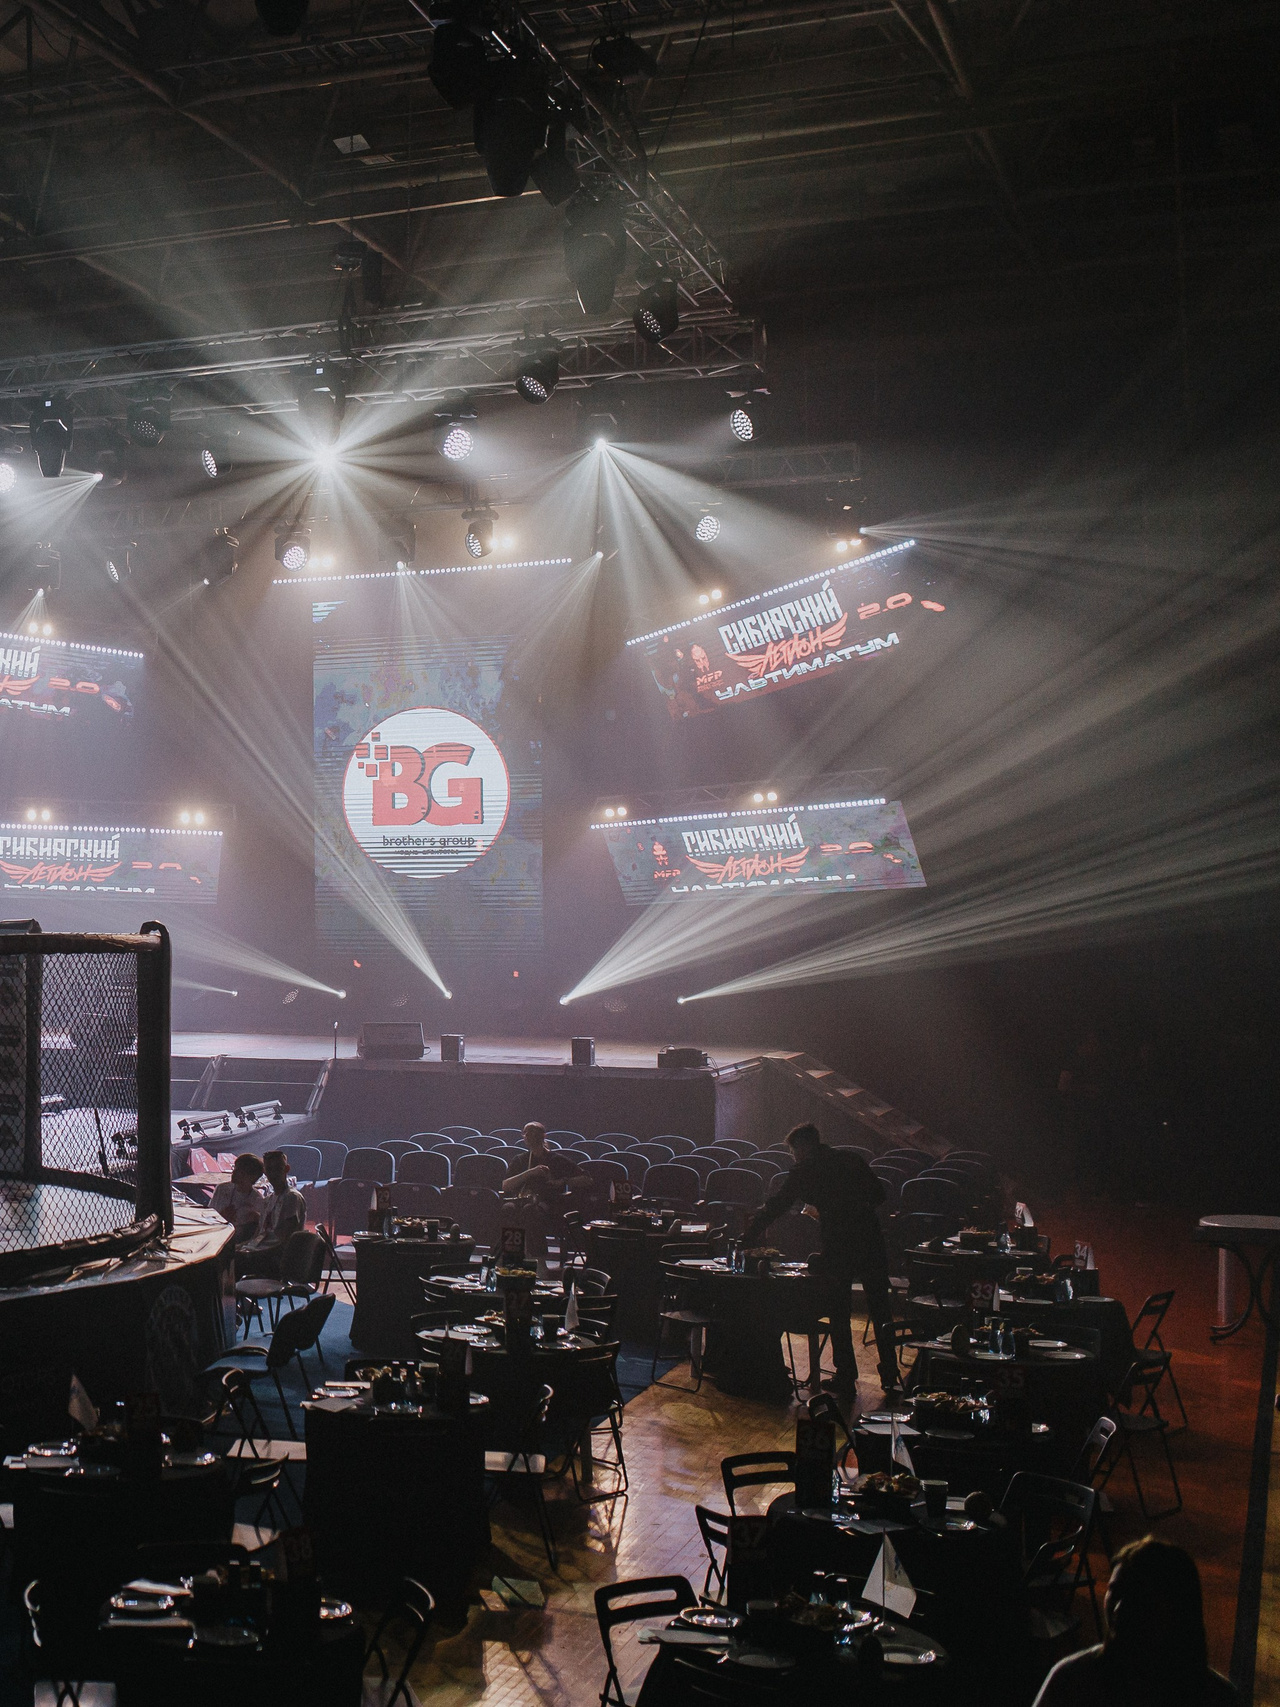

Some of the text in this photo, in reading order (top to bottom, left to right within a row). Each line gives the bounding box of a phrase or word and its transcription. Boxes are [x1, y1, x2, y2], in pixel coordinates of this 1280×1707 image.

[718, 579, 844, 655] СИБИРСКИЙ
[857, 592, 913, 620] 2.0
[715, 632, 900, 701] УЛЬТИМАТУМ
[372, 742, 485, 827] BG
[439, 836, 475, 849] group
[504, 1230, 521, 1245] 28
[1074, 1243, 1088, 1260] 34
[971, 1282, 993, 1300] 33
[997, 1368, 1025, 1388] 35
[799, 1425, 830, 1450] 36
[732, 1519, 767, 1549] 37
